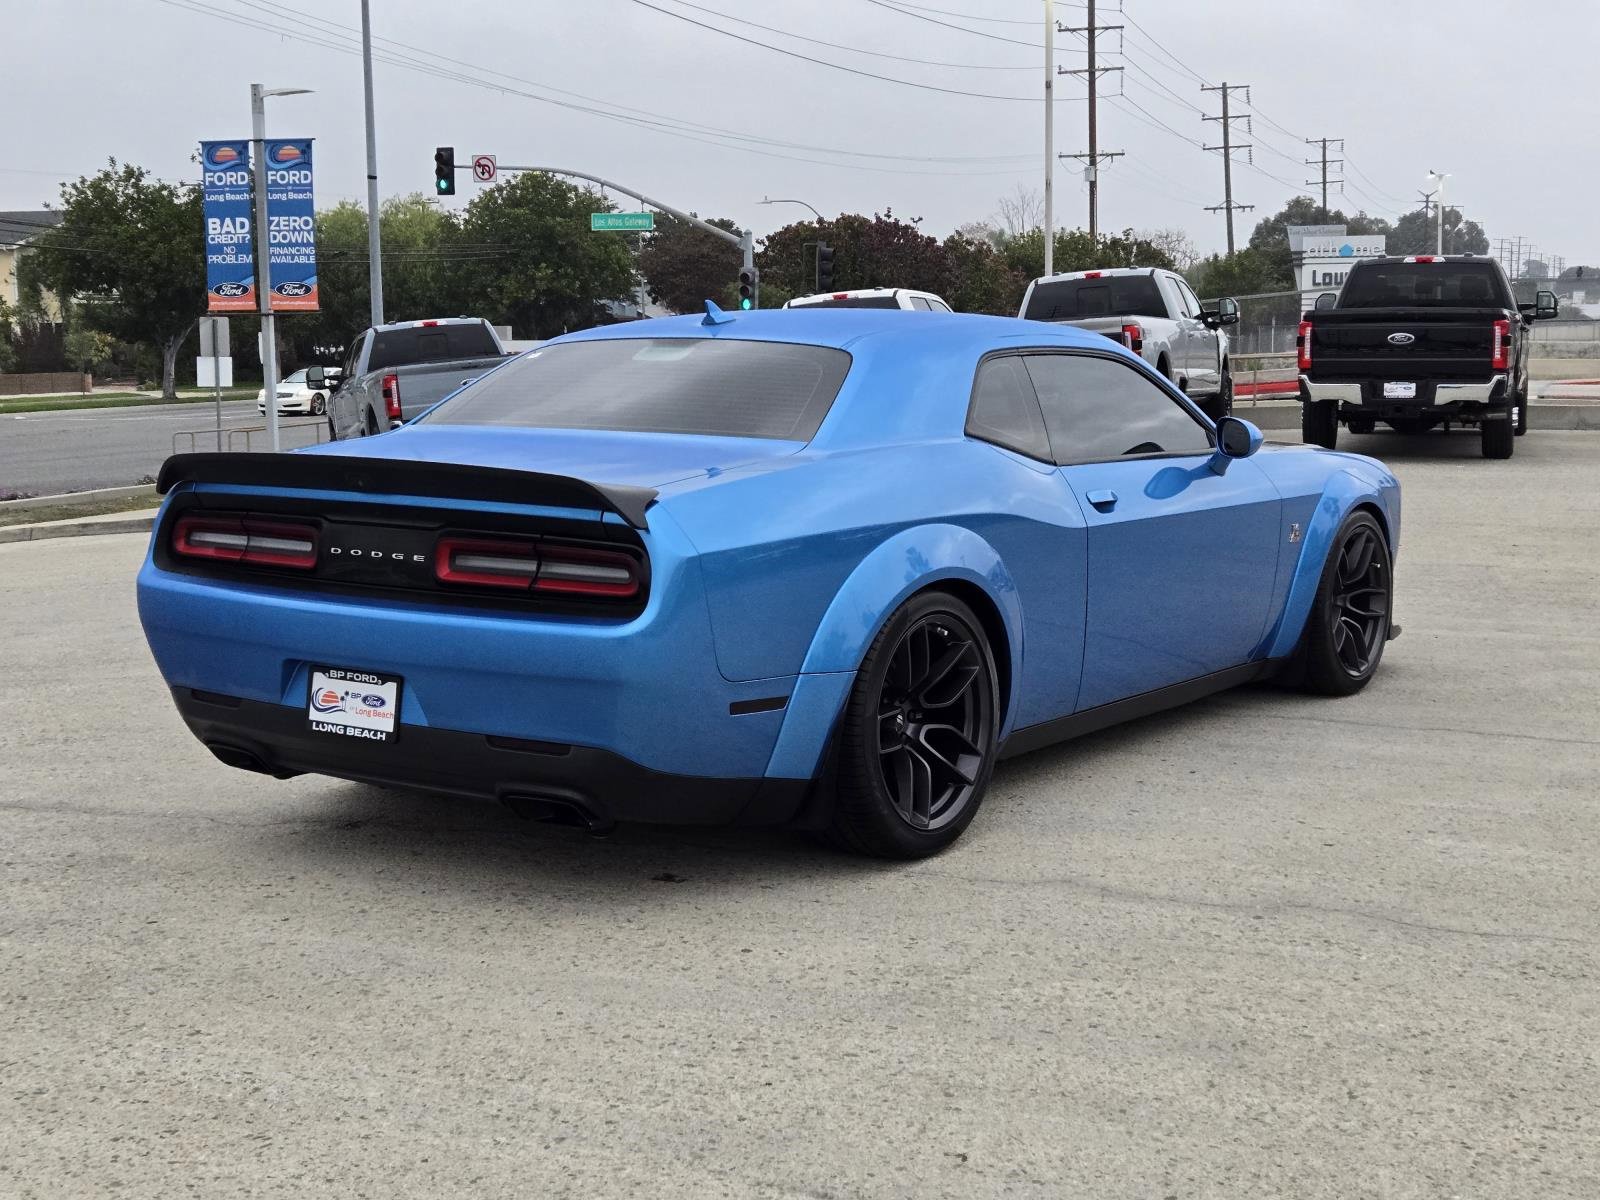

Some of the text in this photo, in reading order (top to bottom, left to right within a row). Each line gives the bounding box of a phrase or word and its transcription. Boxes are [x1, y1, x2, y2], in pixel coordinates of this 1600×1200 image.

[205, 171, 249, 186] FORD
[267, 170, 312, 185] FORD
[205, 192, 250, 202] Long Beach
[268, 191, 312, 200] Long Beach
[207, 217, 250, 235] BAD
[269, 216, 313, 231] ZERO
[208, 234, 251, 244] CREDIT?
[270, 231, 314, 244] DOWN
[223, 246, 236, 254] NO
[269, 246, 315, 255] FINANCING
[208, 254, 253, 265] PROBLEM
[270, 255, 315, 264] AVAILABLE
[219, 284, 243, 296] Ford
[281, 283, 306, 296] Ford
[330, 547, 425, 562] DODGE
[329, 669, 378, 684] BP FORD
[365, 696, 382, 706] Ford
[355, 707, 394, 720] Long Beach
[312, 721, 386, 741] LONG BEACH
